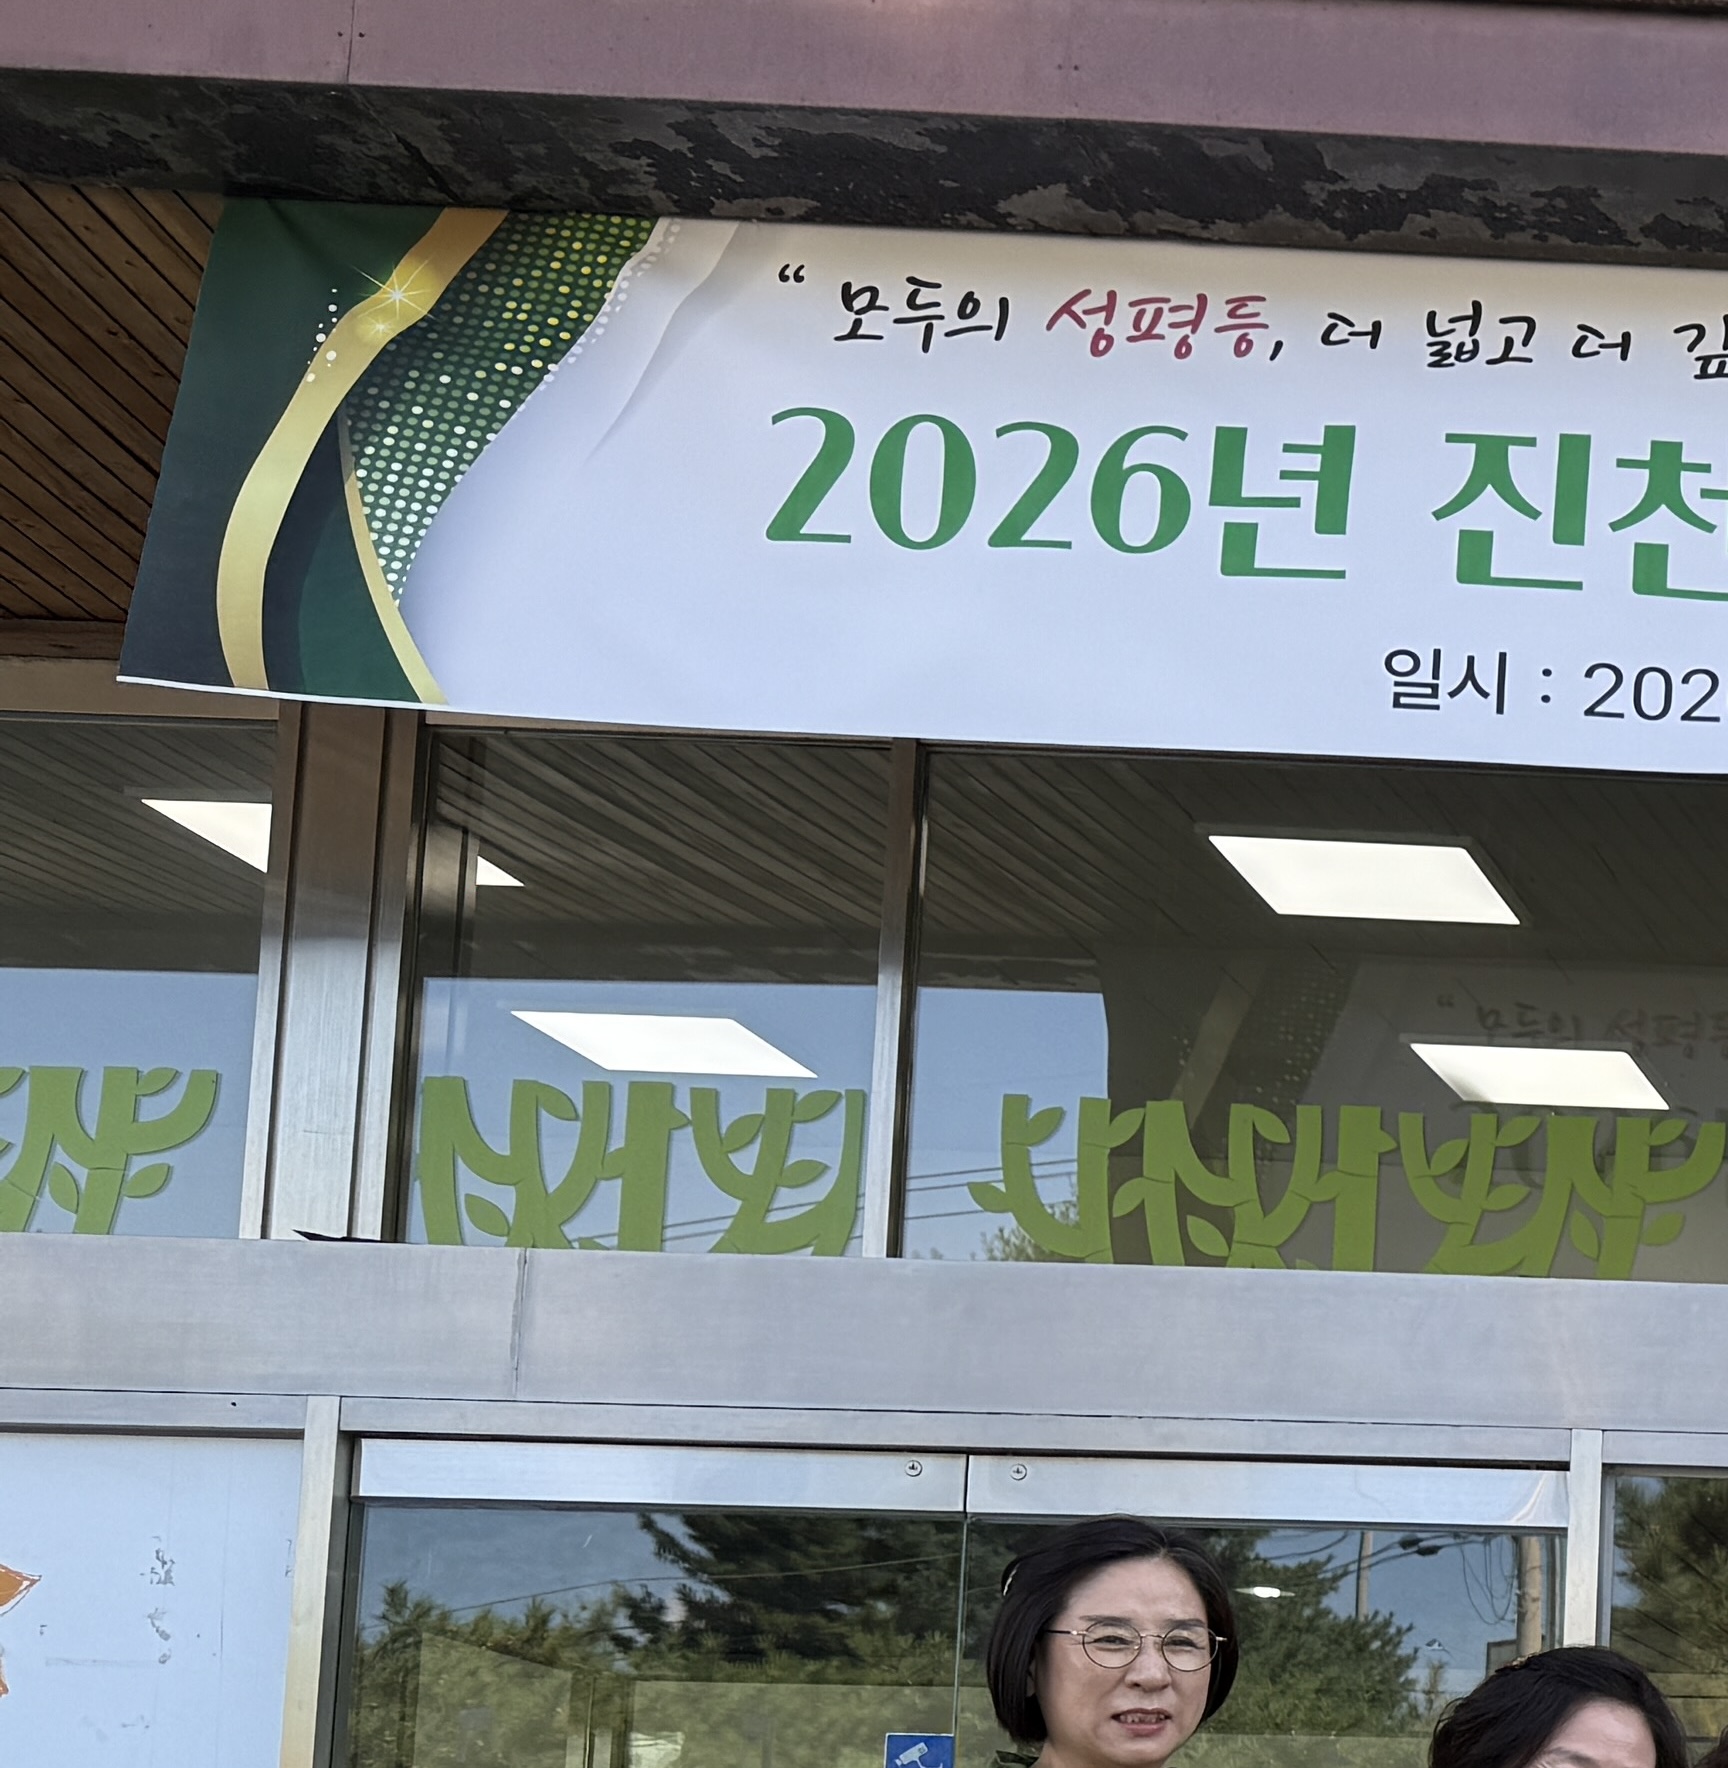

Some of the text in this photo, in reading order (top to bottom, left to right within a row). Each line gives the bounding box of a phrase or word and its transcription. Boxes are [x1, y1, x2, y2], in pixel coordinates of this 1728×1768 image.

[831, 273, 1010, 343] 모두의
[1045, 288, 1284, 362] 성평등,
[1320, 311, 1383, 351] 더
[1425, 299, 1537, 369] 넓고
[1571, 326, 1632, 363] 더
[765, 406, 1357, 580] 2026년
[1383, 647, 1508, 716] 일시
